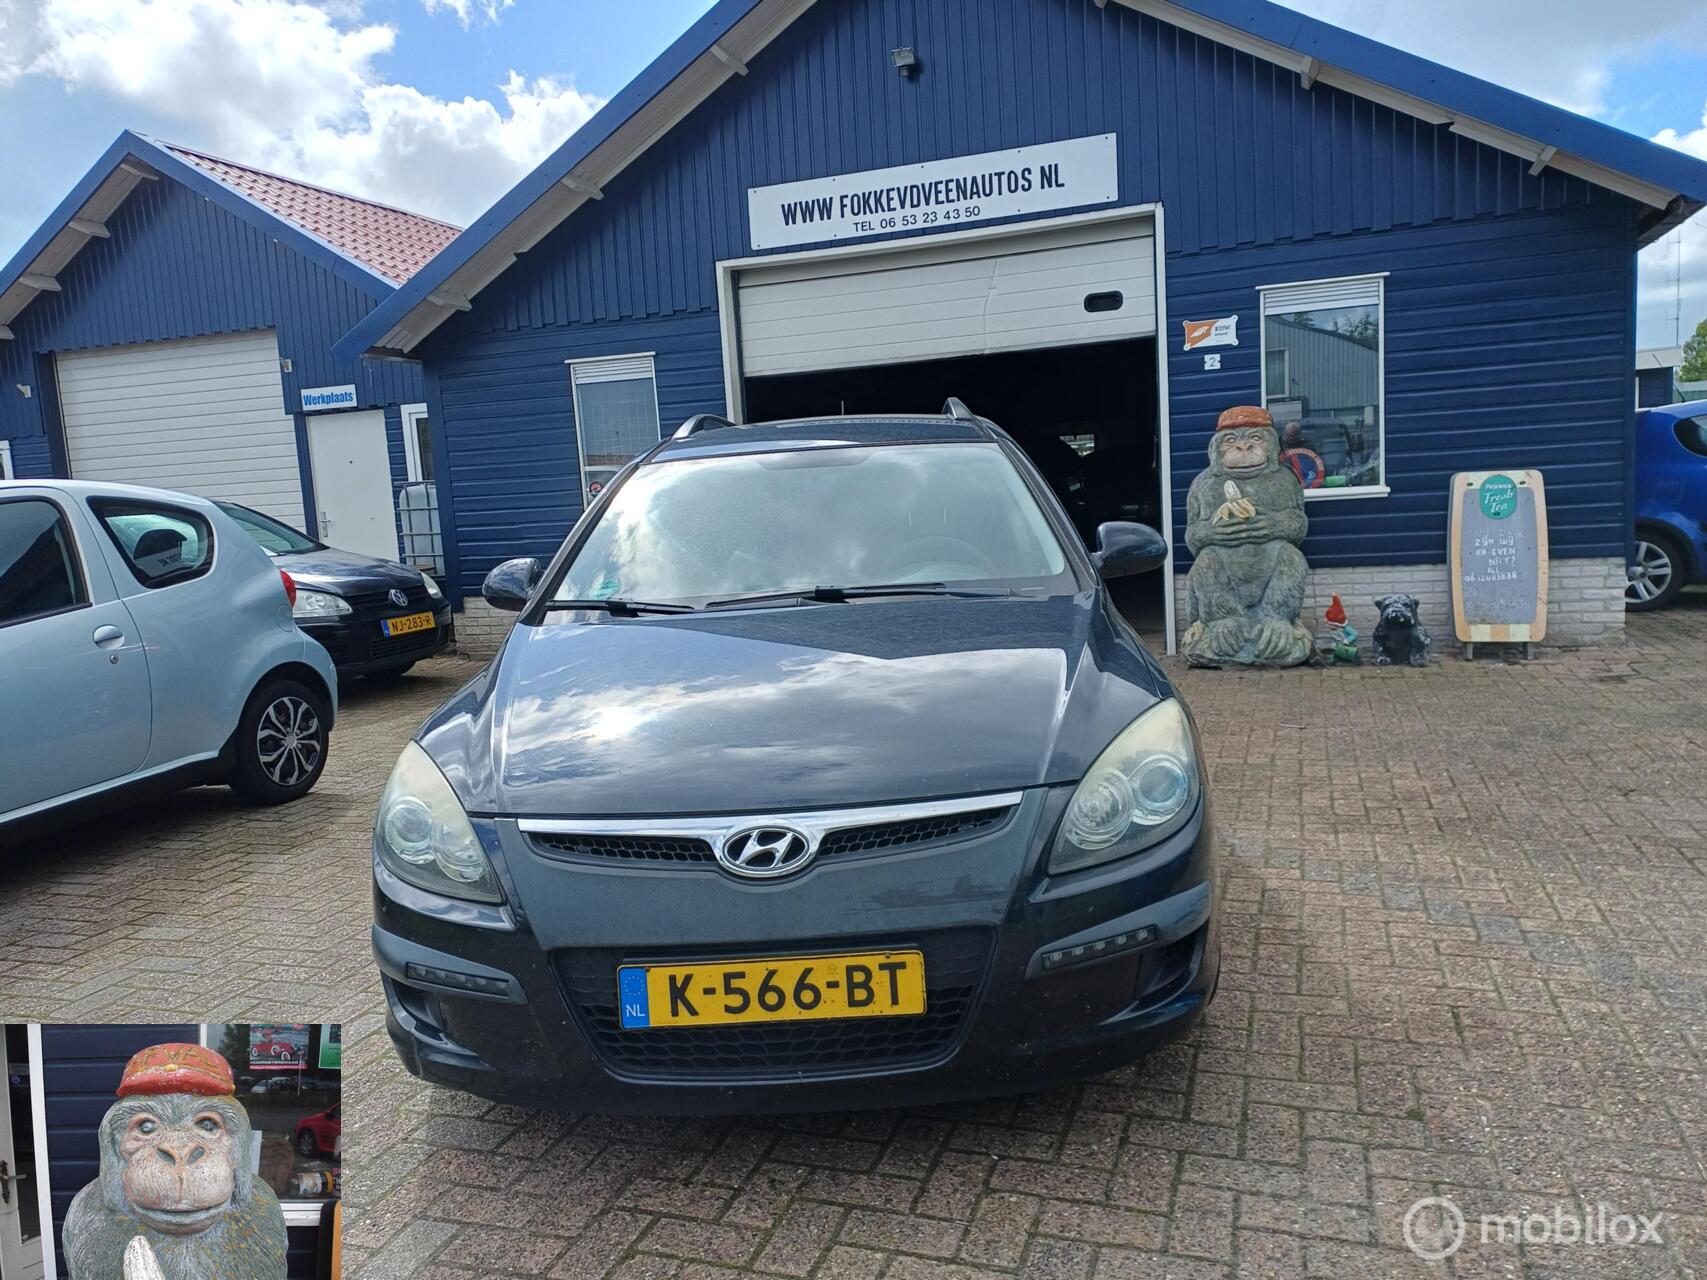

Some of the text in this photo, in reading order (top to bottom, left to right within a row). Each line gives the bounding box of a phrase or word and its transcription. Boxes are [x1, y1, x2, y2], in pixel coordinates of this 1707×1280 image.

[781, 163, 1065, 226] WWW FOKKEVDVEENAUTOS NL
[853, 205, 980, 232] TEL 06 53 23 43 50
[1209, 357, 1216, 367] 2
[303, 392, 353, 406] Werkplaats
[391, 615, 432, 632] NJ-283-R
[625, 961, 907, 1017] NL K-566-BT
